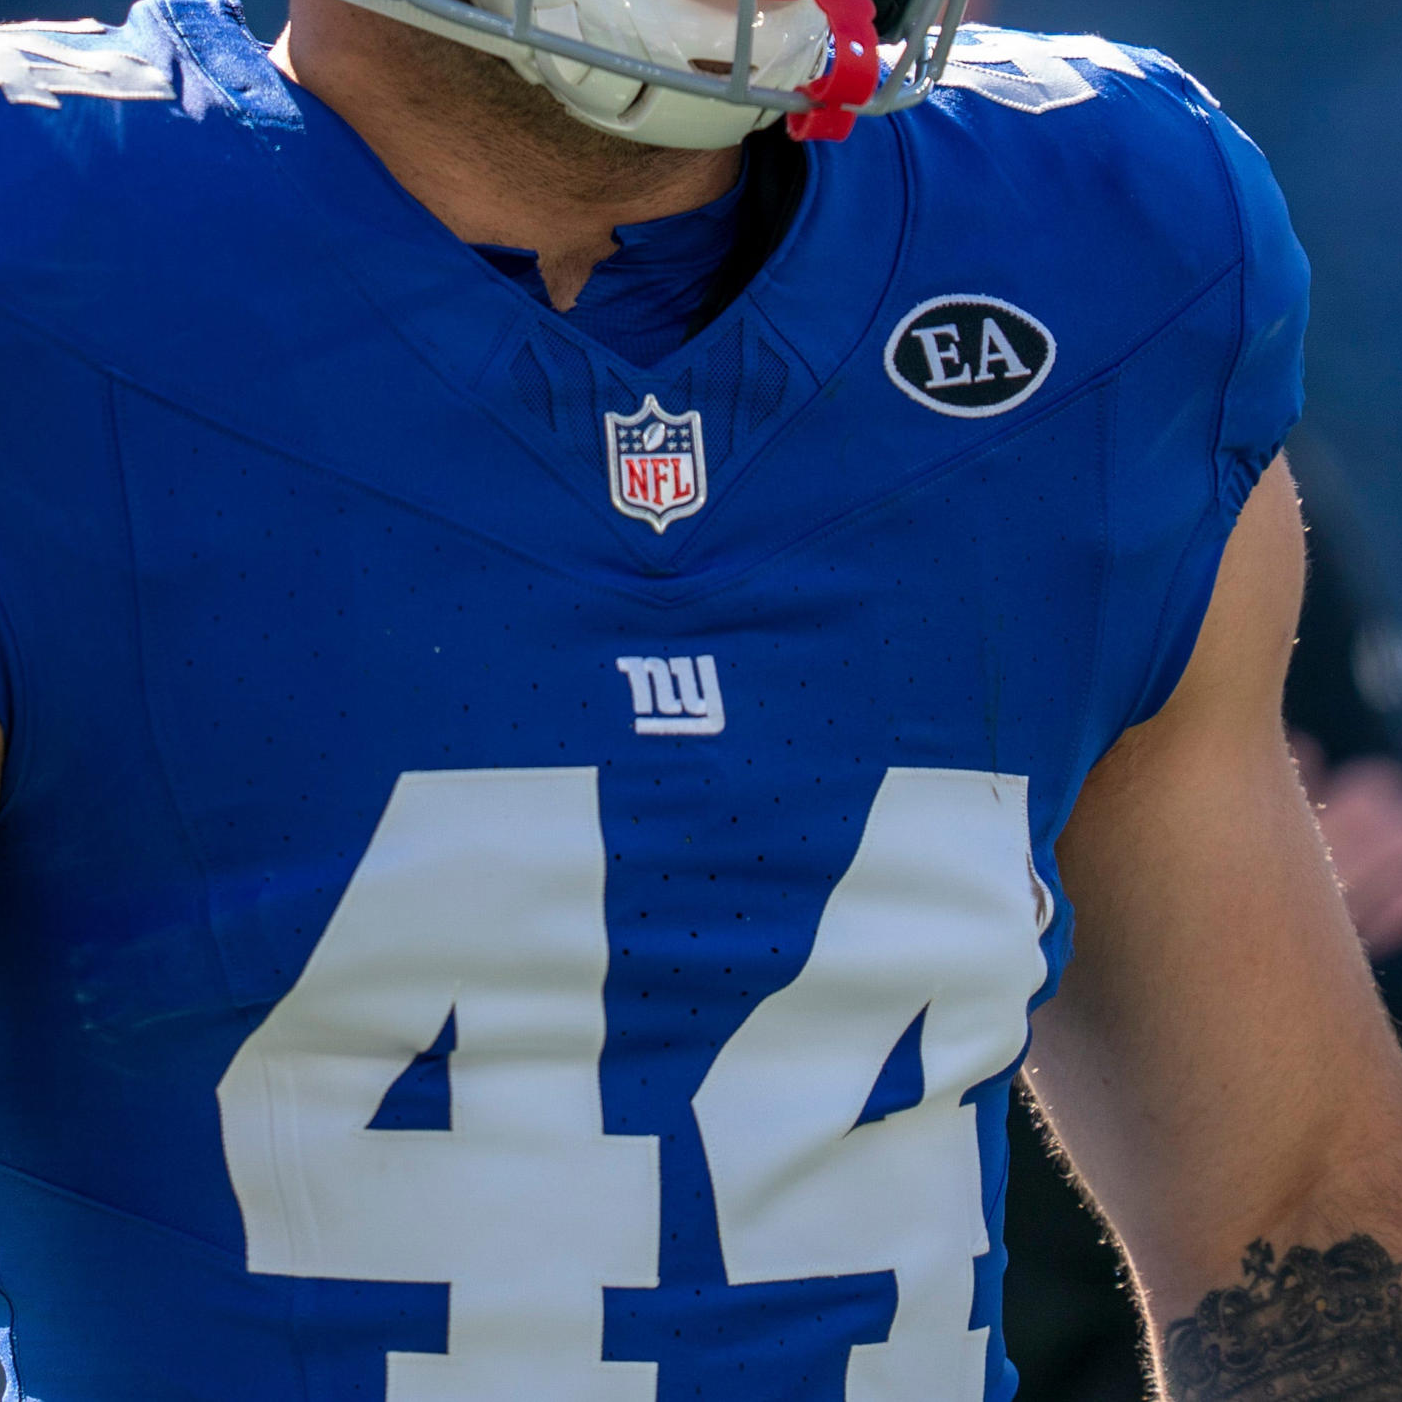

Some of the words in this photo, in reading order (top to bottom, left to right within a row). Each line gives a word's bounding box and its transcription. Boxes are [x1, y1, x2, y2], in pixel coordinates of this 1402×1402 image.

[912, 317, 1031, 389] EA
[625, 457, 692, 506] NFL
[216, 765, 1054, 1402] 44
